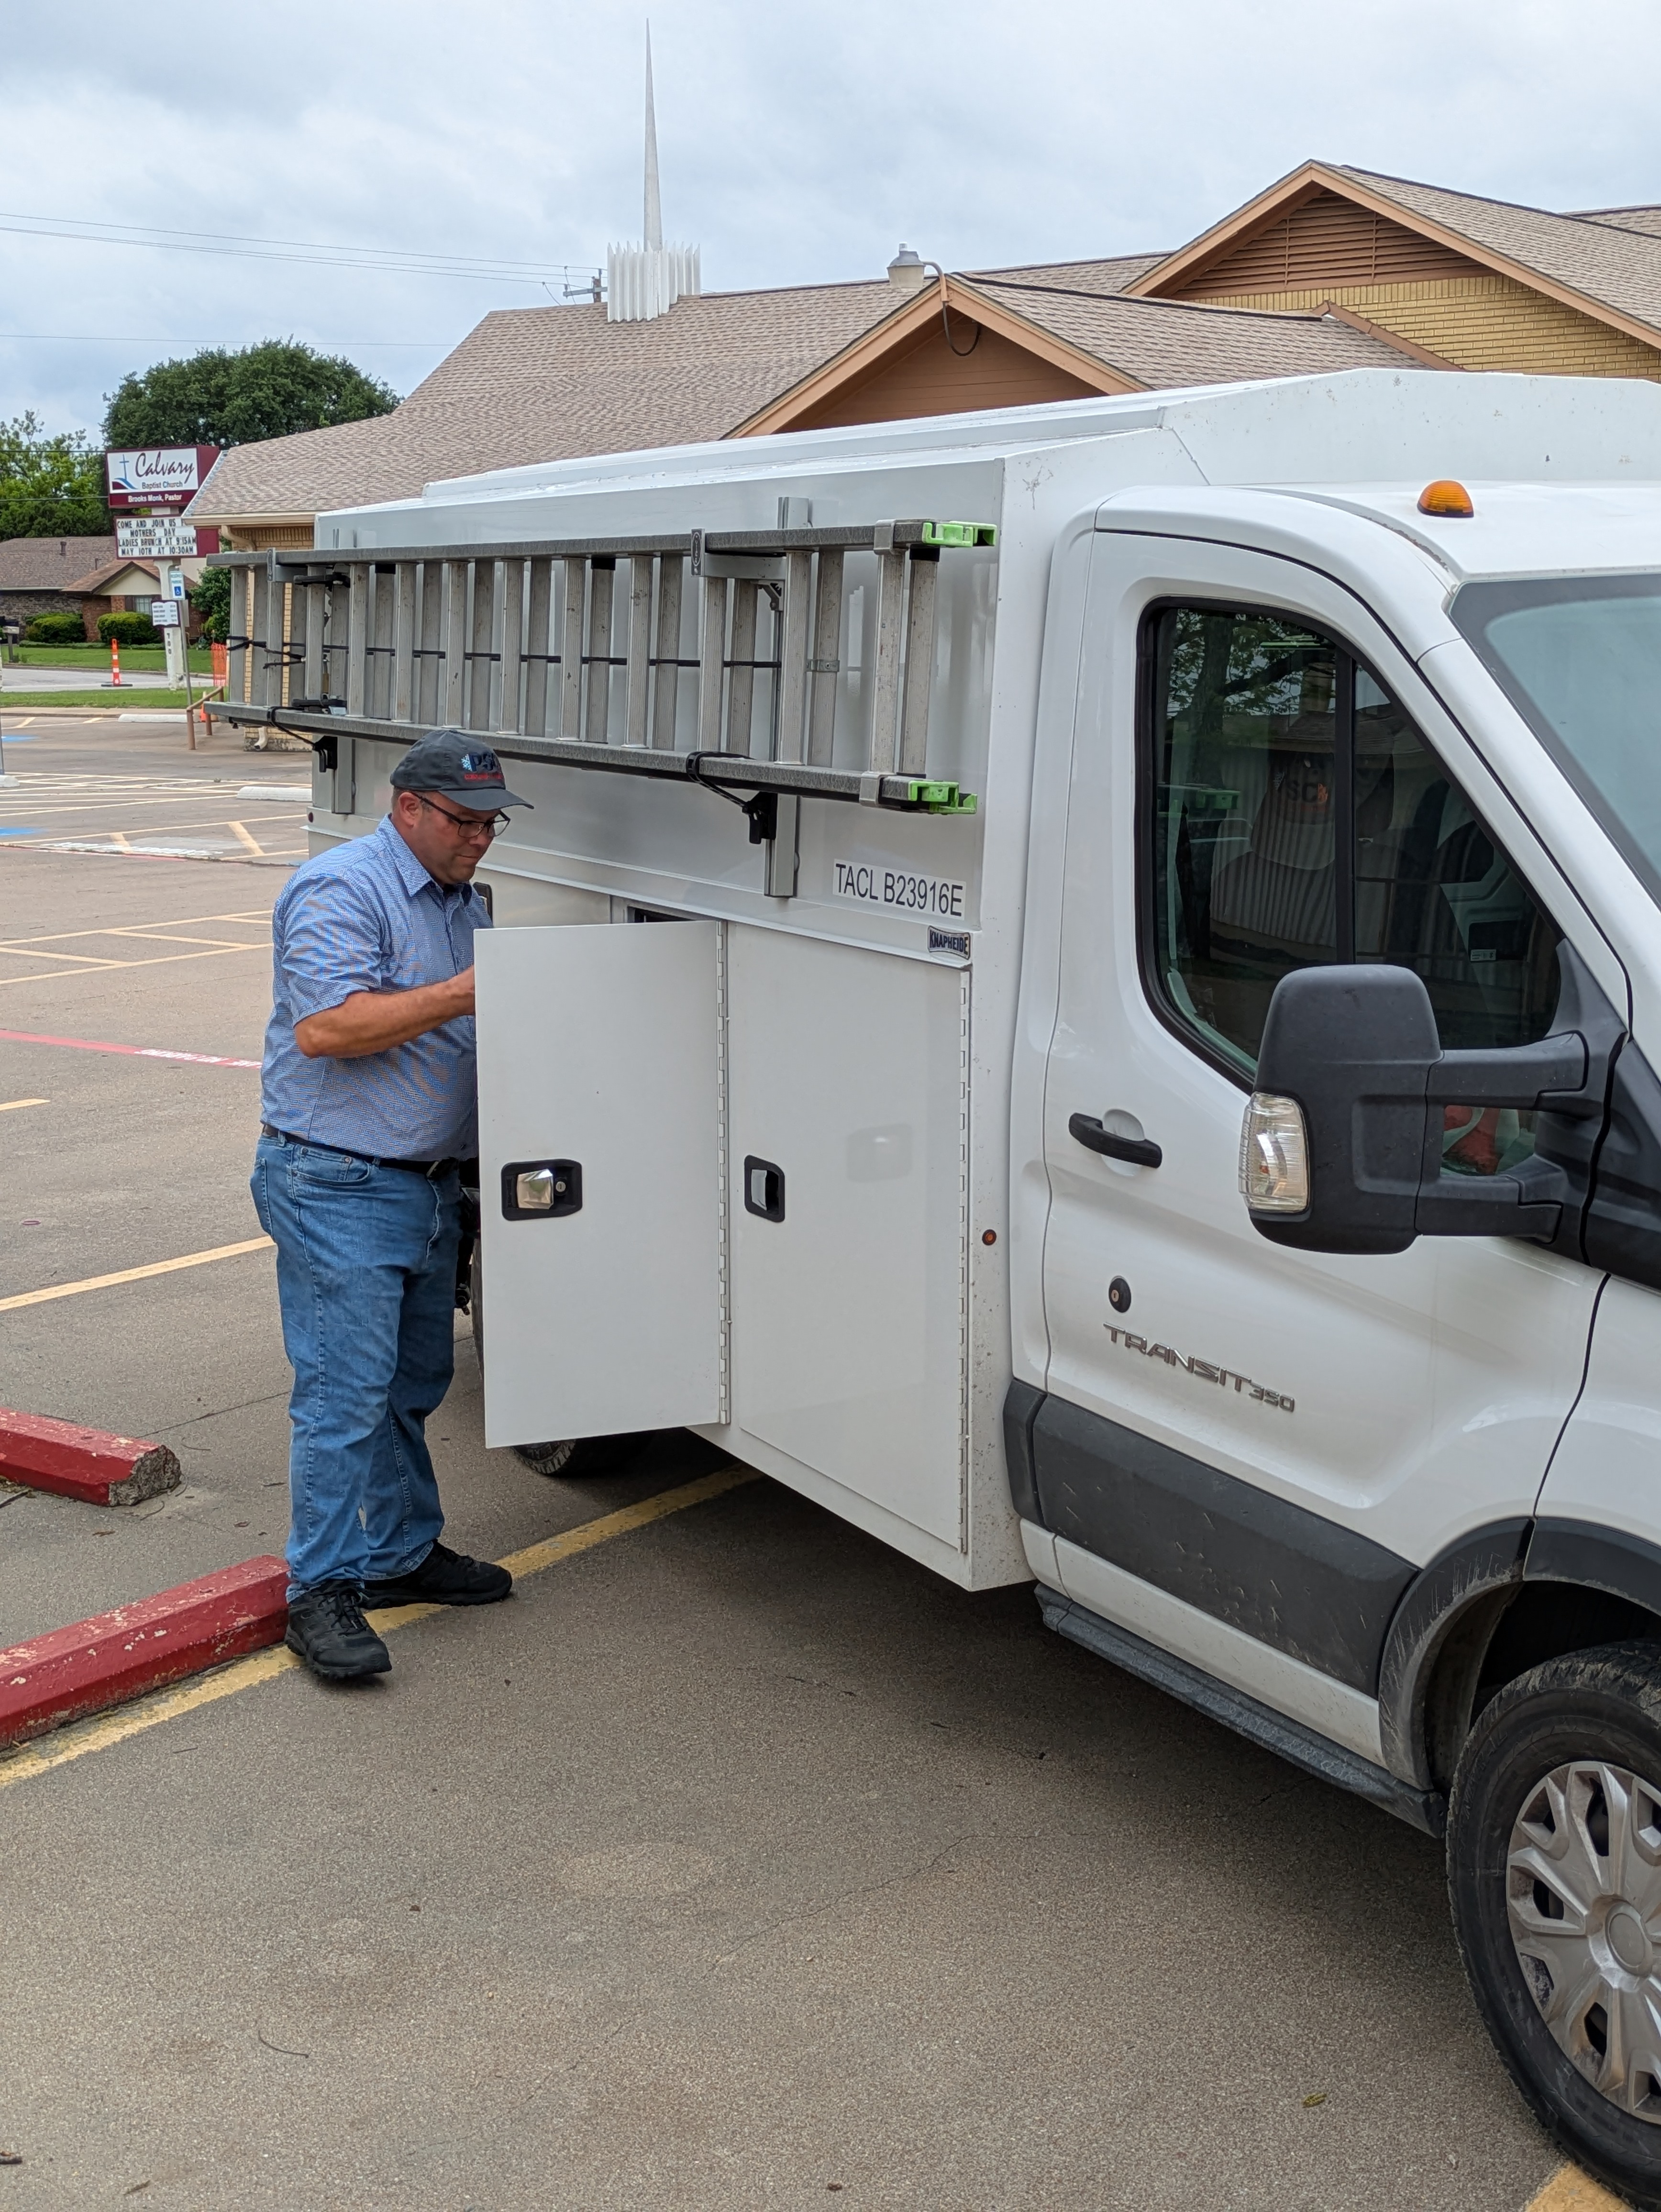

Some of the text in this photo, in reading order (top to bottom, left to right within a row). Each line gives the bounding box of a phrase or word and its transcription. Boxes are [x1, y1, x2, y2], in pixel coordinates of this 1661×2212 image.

[135, 451, 194, 484] Calvary
[142, 482, 162, 490] Baptist
[117, 520, 132, 529] COME
[152, 519, 165, 527] JOIN
[169, 519, 176, 527] US
[130, 528, 176, 537] MOTHERS DAY
[166, 537, 172, 545] AT
[122, 548, 134, 556] MAY
[836, 863, 963, 917] TACL B23916E
[1103, 1322, 1295, 1413] TRANSIT 350
